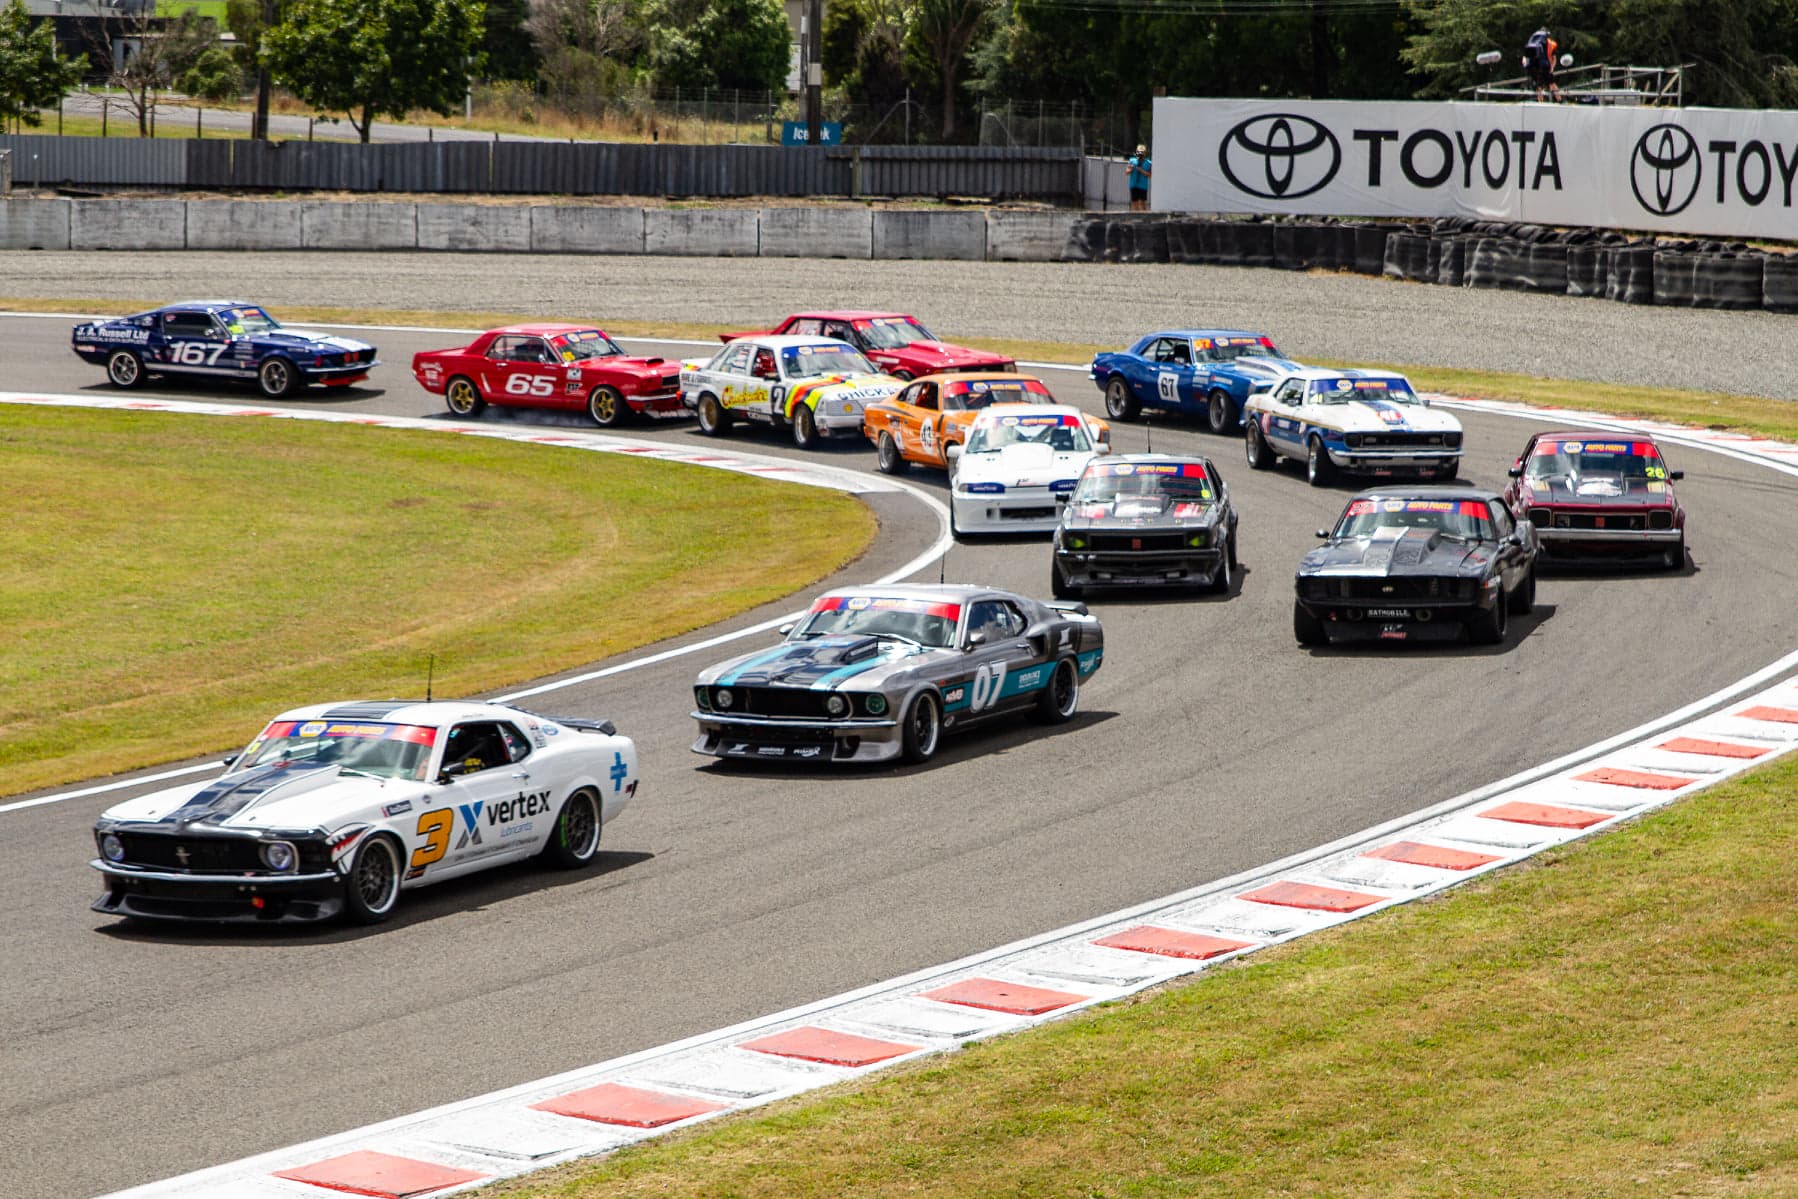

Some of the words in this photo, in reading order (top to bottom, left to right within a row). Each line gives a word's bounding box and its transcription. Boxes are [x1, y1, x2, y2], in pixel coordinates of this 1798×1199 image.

[1353, 129, 1563, 191] TOYOTA
[1708, 139, 1798, 208] TOY
[98, 327, 132, 338] Russell
[133, 329, 150, 340] Ltd
[170, 341, 229, 366] 167
[504, 372, 557, 397] 65
[1161, 377, 1175, 398] 67
[773, 387, 785, 415] 2
[970, 660, 1008, 714] 07
[487, 790, 552, 827] vertex
[410, 806, 455, 869] 3
